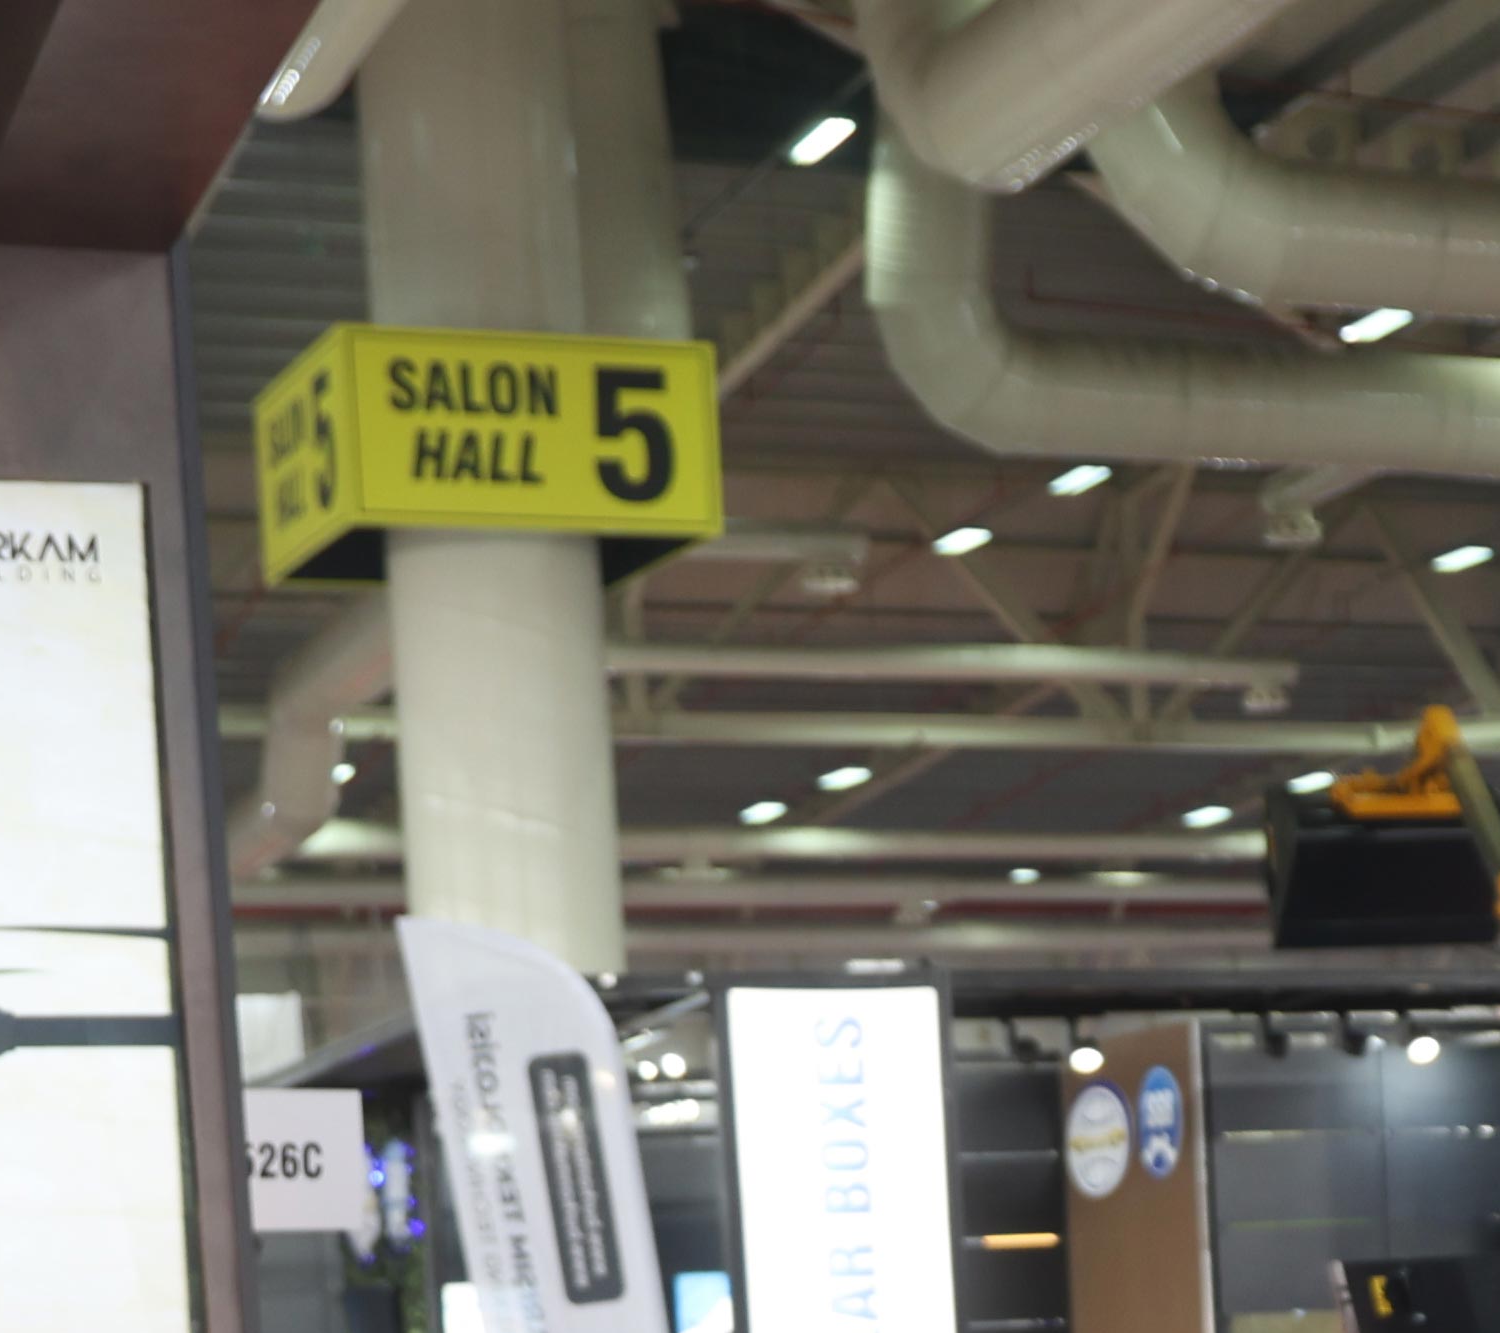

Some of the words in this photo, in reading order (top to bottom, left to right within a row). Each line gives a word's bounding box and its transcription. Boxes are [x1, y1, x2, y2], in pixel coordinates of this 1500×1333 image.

[387, 357, 560, 418] SALON
[593, 362, 677, 504] 5
[412, 428, 546, 486] HALL
[815, 1014, 873, 1220] BOXES
